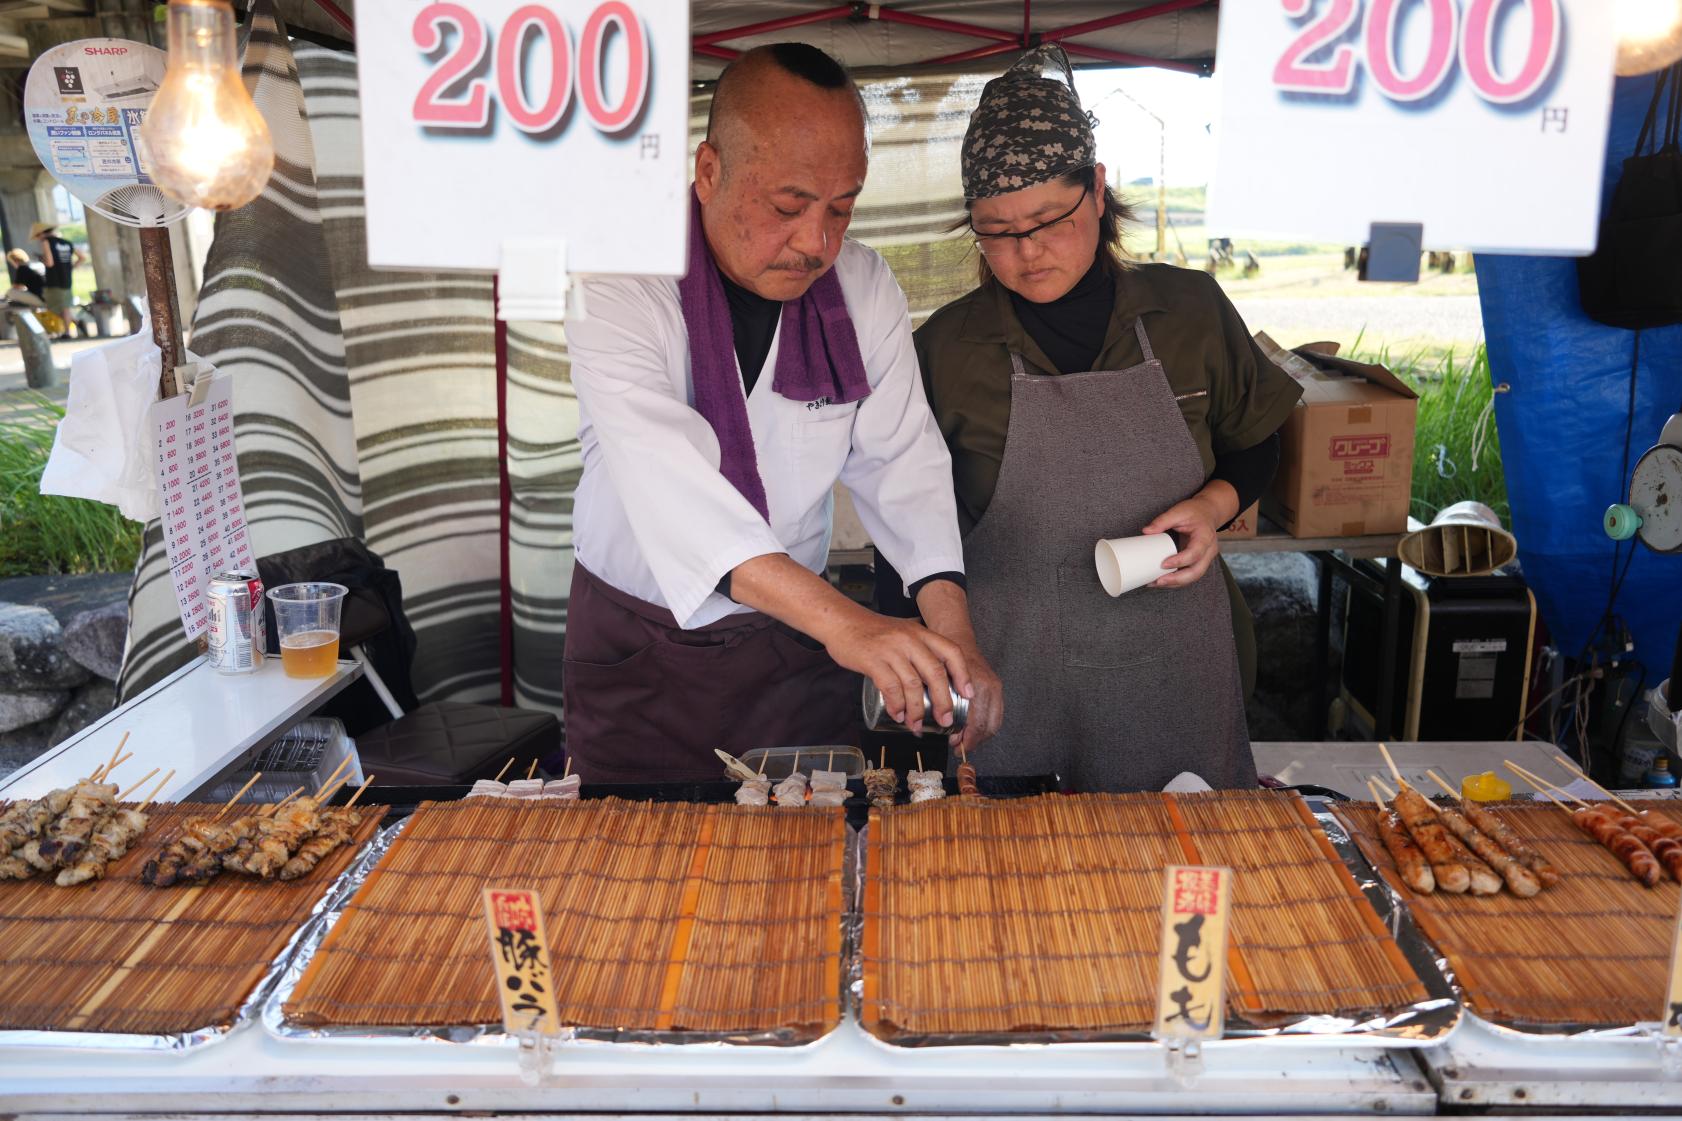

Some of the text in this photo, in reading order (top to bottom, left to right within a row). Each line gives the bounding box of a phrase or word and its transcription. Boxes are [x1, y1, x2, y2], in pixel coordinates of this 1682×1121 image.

[84, 47, 128, 56] SHARP
[1273, 0, 1564, 112] 200
[412, 1, 653, 140] 200
[1540, 107, 1568, 133] 円
[641, 134, 660, 160] 円
[218, 400, 228, 408] 6200
[193, 409, 205, 419] 3200
[166, 420, 175, 429] 200
[186, 423, 205, 436] 17 3400
[167, 435, 175, 443] 400
[187, 437, 205, 450] 18 3600
[220, 440, 231, 449] 6800
[1334, 438, 1387, 455] クレープ
[167, 449, 176, 458] 600
[188, 450, 207, 464] 19 3800
[215, 453, 232, 466] 35 7000
[169, 464, 178, 473] 800
[190, 464, 208, 478] 20 4000
[223, 466, 234, 475] 7200
[168, 478, 180, 488] 1000
[192, 478, 211, 492] 21 4200
[170, 492, 182, 503] 1200
[194, 491, 212, 506] 22 4400
[173, 506, 184, 517] 1400
[196, 505, 214, 520] 23 4600
[175, 521, 187, 532] 1600
[198, 519, 217, 534] 24 4800
[232, 519, 242, 529] 8000
[177, 535, 189, 545] 1800
[208, 532, 219, 543] 5000
[179, 548, 191, 560] 2000
[210, 545, 222, 556] 5200
[237, 544, 247, 555] 8400
[175, 562, 193, 578] 11 2200
[205, 558, 224, 575] 27 5400
[177, 584, 183, 592] 12
[185, 576, 196, 587] 2400
[181, 590, 200, 605] 13 2600
[184, 611, 190, 620] 14
[192, 603, 204, 615] 2800
[188, 615, 208, 633] 15 3000
[495, 926, 548, 1030] 豚バラ
[1164, 913, 1213, 1030] もも
